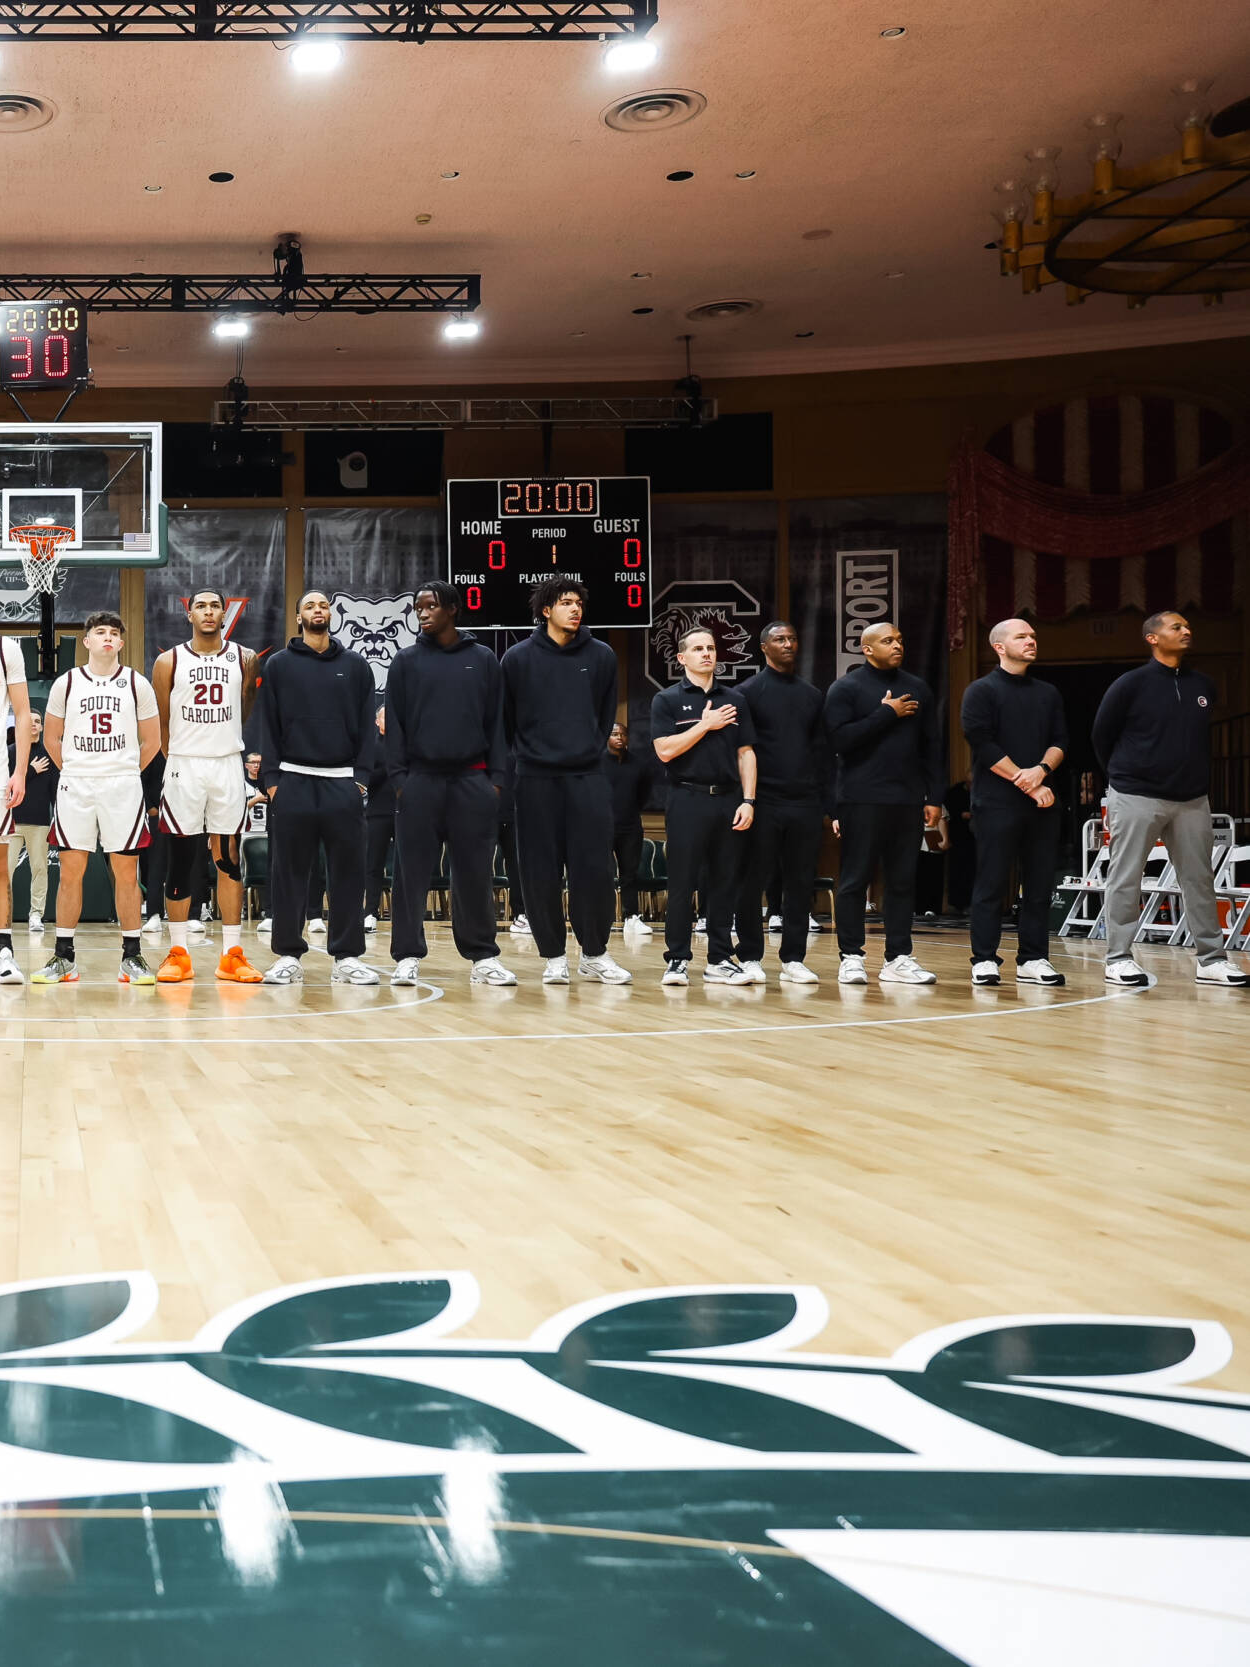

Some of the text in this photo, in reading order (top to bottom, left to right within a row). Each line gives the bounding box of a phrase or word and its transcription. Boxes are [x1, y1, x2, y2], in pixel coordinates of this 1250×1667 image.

[6, 307, 79, 332] 20:00
[10, 335, 69, 378] 30
[505, 483, 594, 513] 20:00
[461, 520, 502, 536] HOME
[532, 528, 567, 539] PERIOD
[593, 518, 640, 534] GUEST
[488, 540, 506, 570] 0
[551, 544, 557, 564] 1
[623, 538, 642, 568] 0
[454, 574, 486, 585] FOULS
[559, 572, 583, 583] OUL
[614, 571, 646, 582] FOULS
[467, 586, 482, 610] 0
[627, 584, 642, 608] 0
[189, 666, 229, 684] SOUTH
[80, 695, 121, 714] SOUTH
[194, 684, 223, 705] 20
[90, 713, 112, 734] 15
[73, 734, 126, 753] CAROLINA
